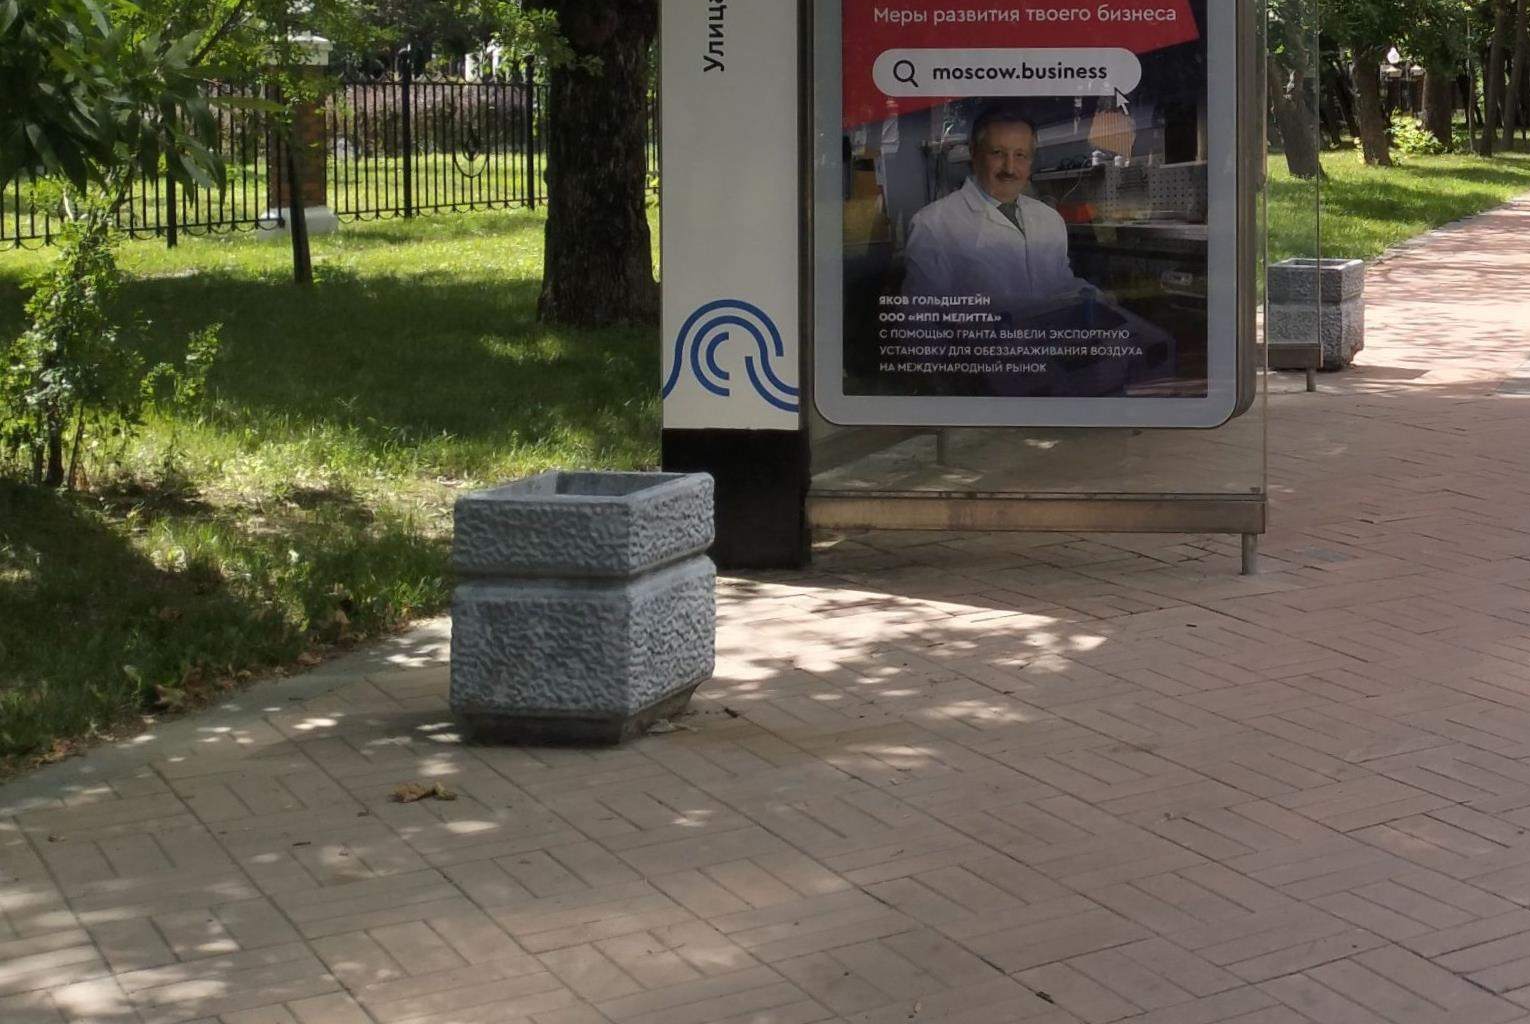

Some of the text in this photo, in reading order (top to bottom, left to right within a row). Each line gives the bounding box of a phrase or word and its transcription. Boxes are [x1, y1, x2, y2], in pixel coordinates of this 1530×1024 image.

[873, 3, 1178, 26] Меры развития твоего бизнеса
[932, 61, 1109, 81] moscow.business
[879, 293, 992, 307] ЯКОВ ГОЛЬДШТЕЙН
[879, 312, 906, 323] ООО
[942, 312, 1003, 323] МЕЛИТТА»
[879, 329, 1131, 340] С ПОМОЩЬЮ ГРАНТА ВЫВЕЛИ ЭКСПОРТНУЮ
[879, 346, 1143, 357] УСТАНОВКУ ДЛЯ ОБЕЗЗАРАЖИВАНИЯ ВОЗДУХА
[879, 360, 1048, 374] НА МЕЖДУНАРОДНЫЙ РЫНОК
